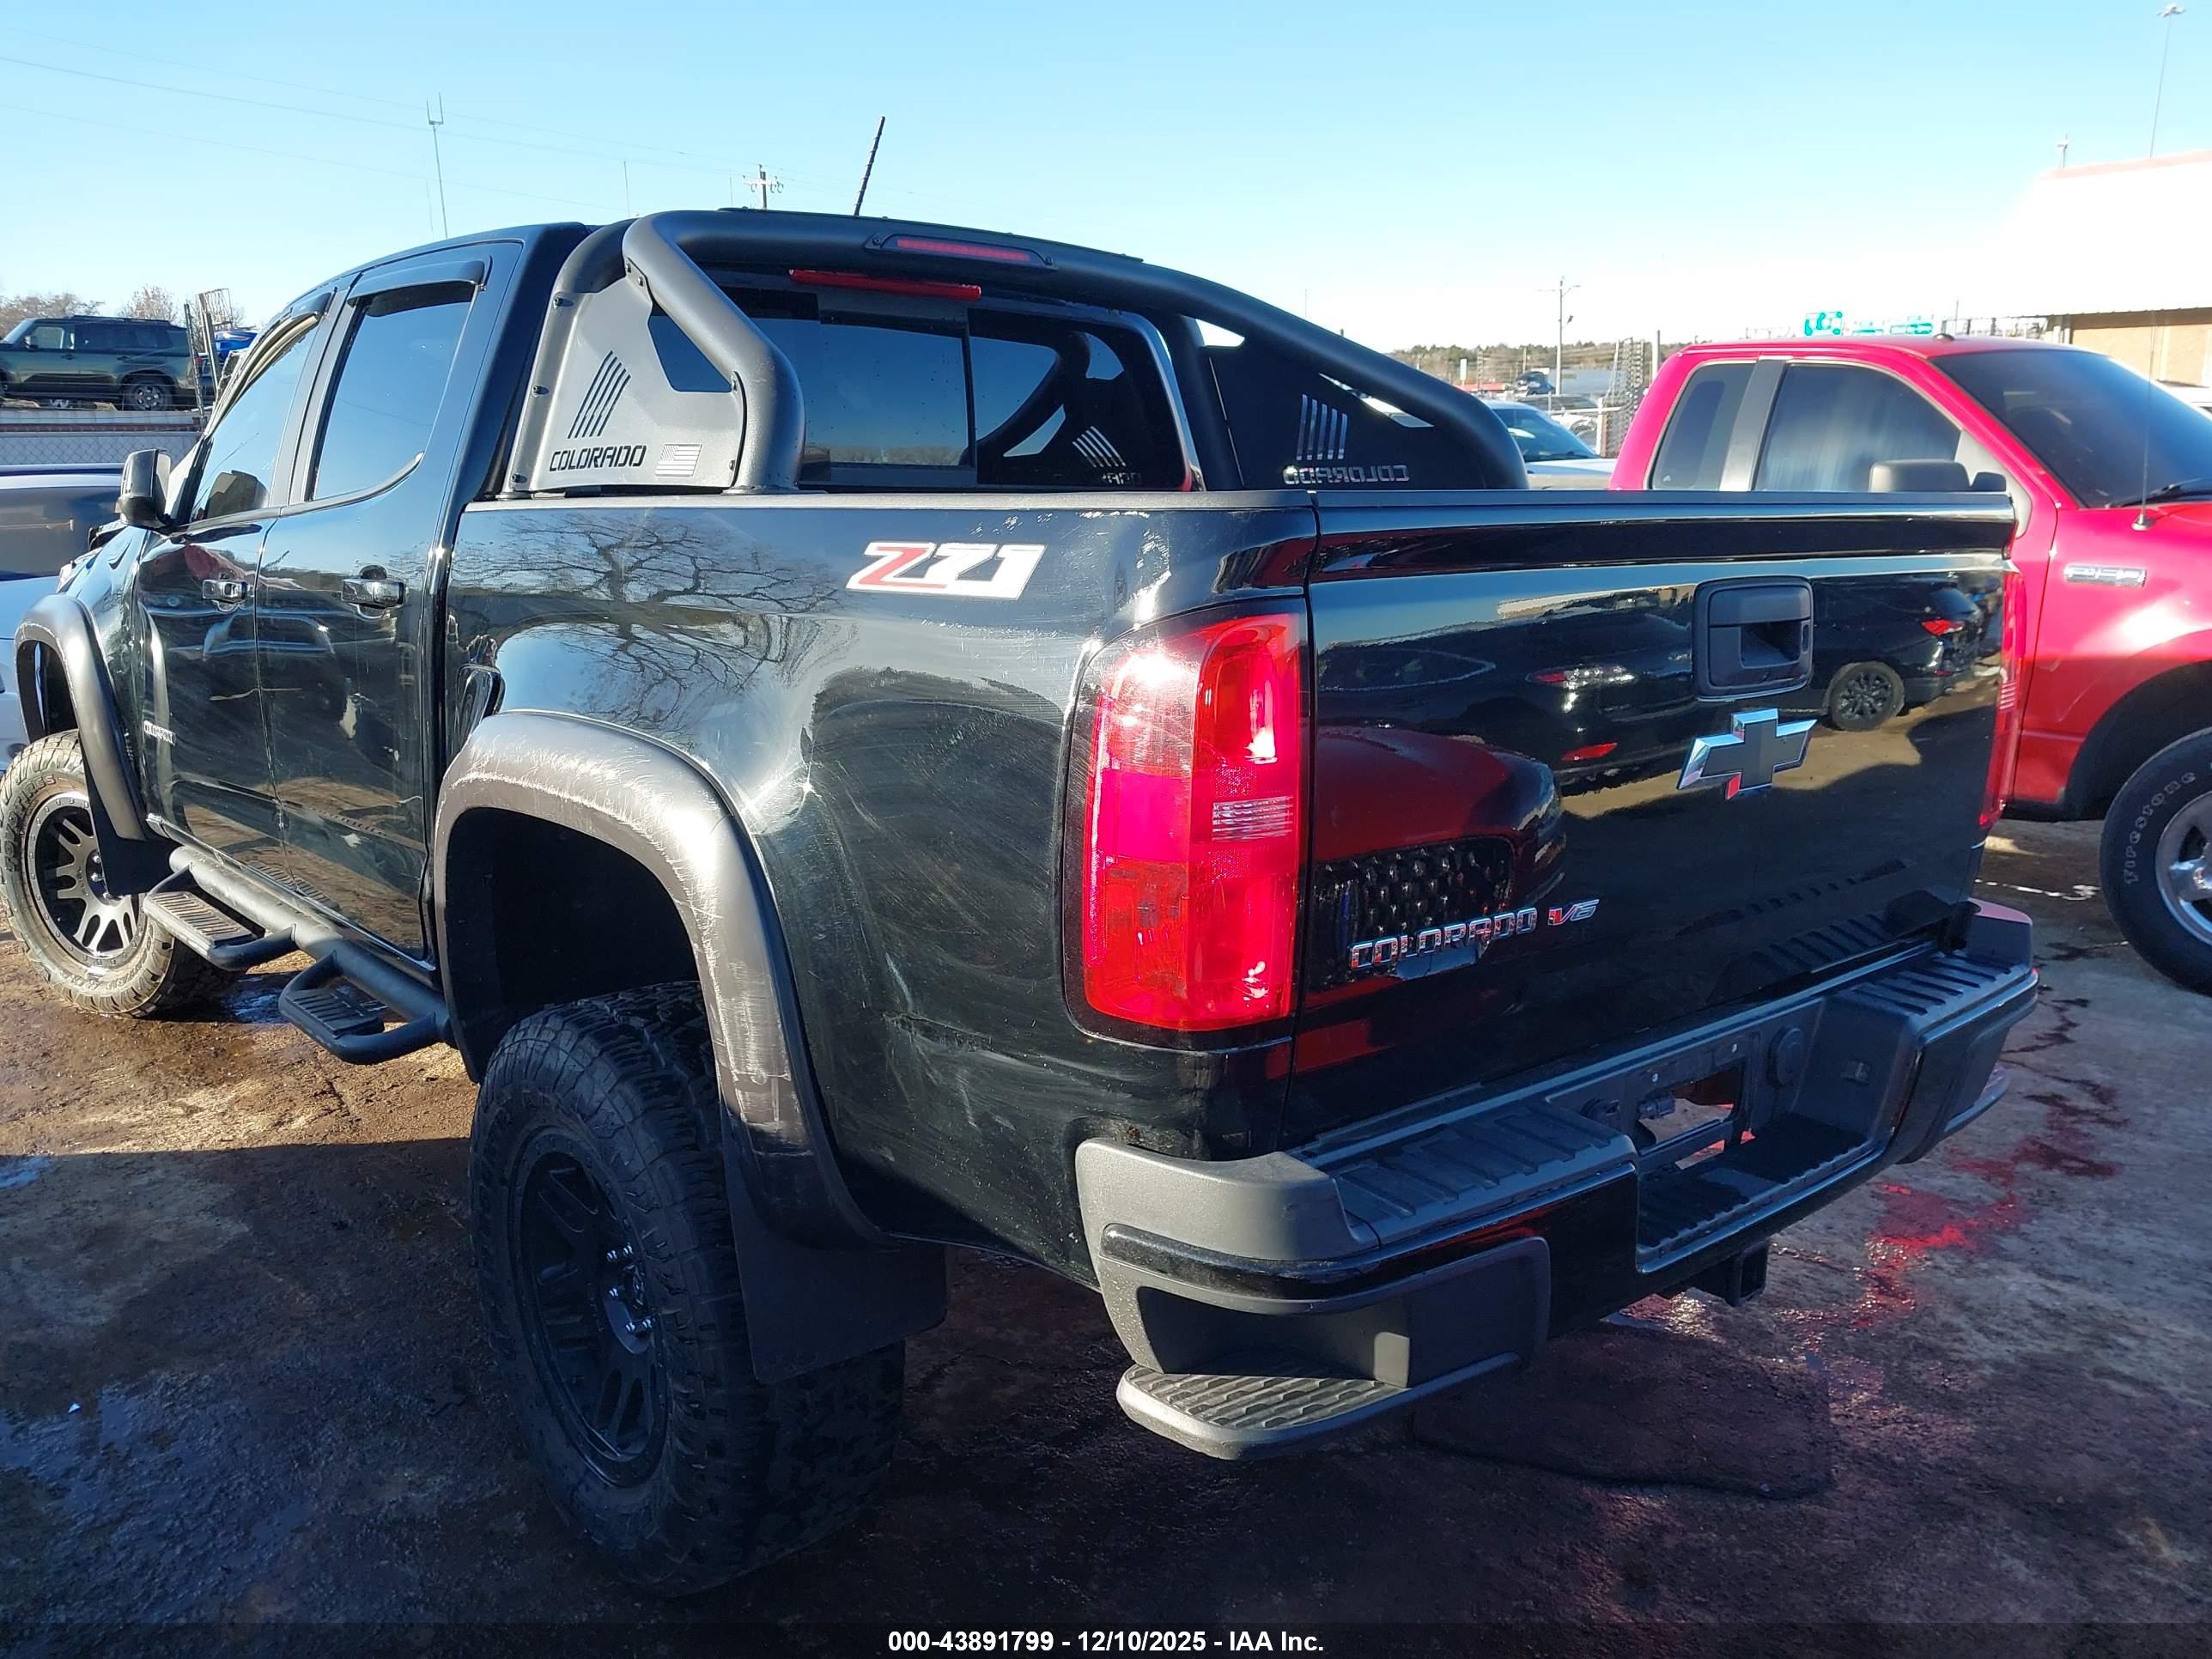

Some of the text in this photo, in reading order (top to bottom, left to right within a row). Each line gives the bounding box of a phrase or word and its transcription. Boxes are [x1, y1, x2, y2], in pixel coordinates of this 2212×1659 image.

[550, 445, 647, 471] COLORADO
[846, 542, 1048, 600] Z71
[1349, 899, 1600, 969] COLORADO V6
